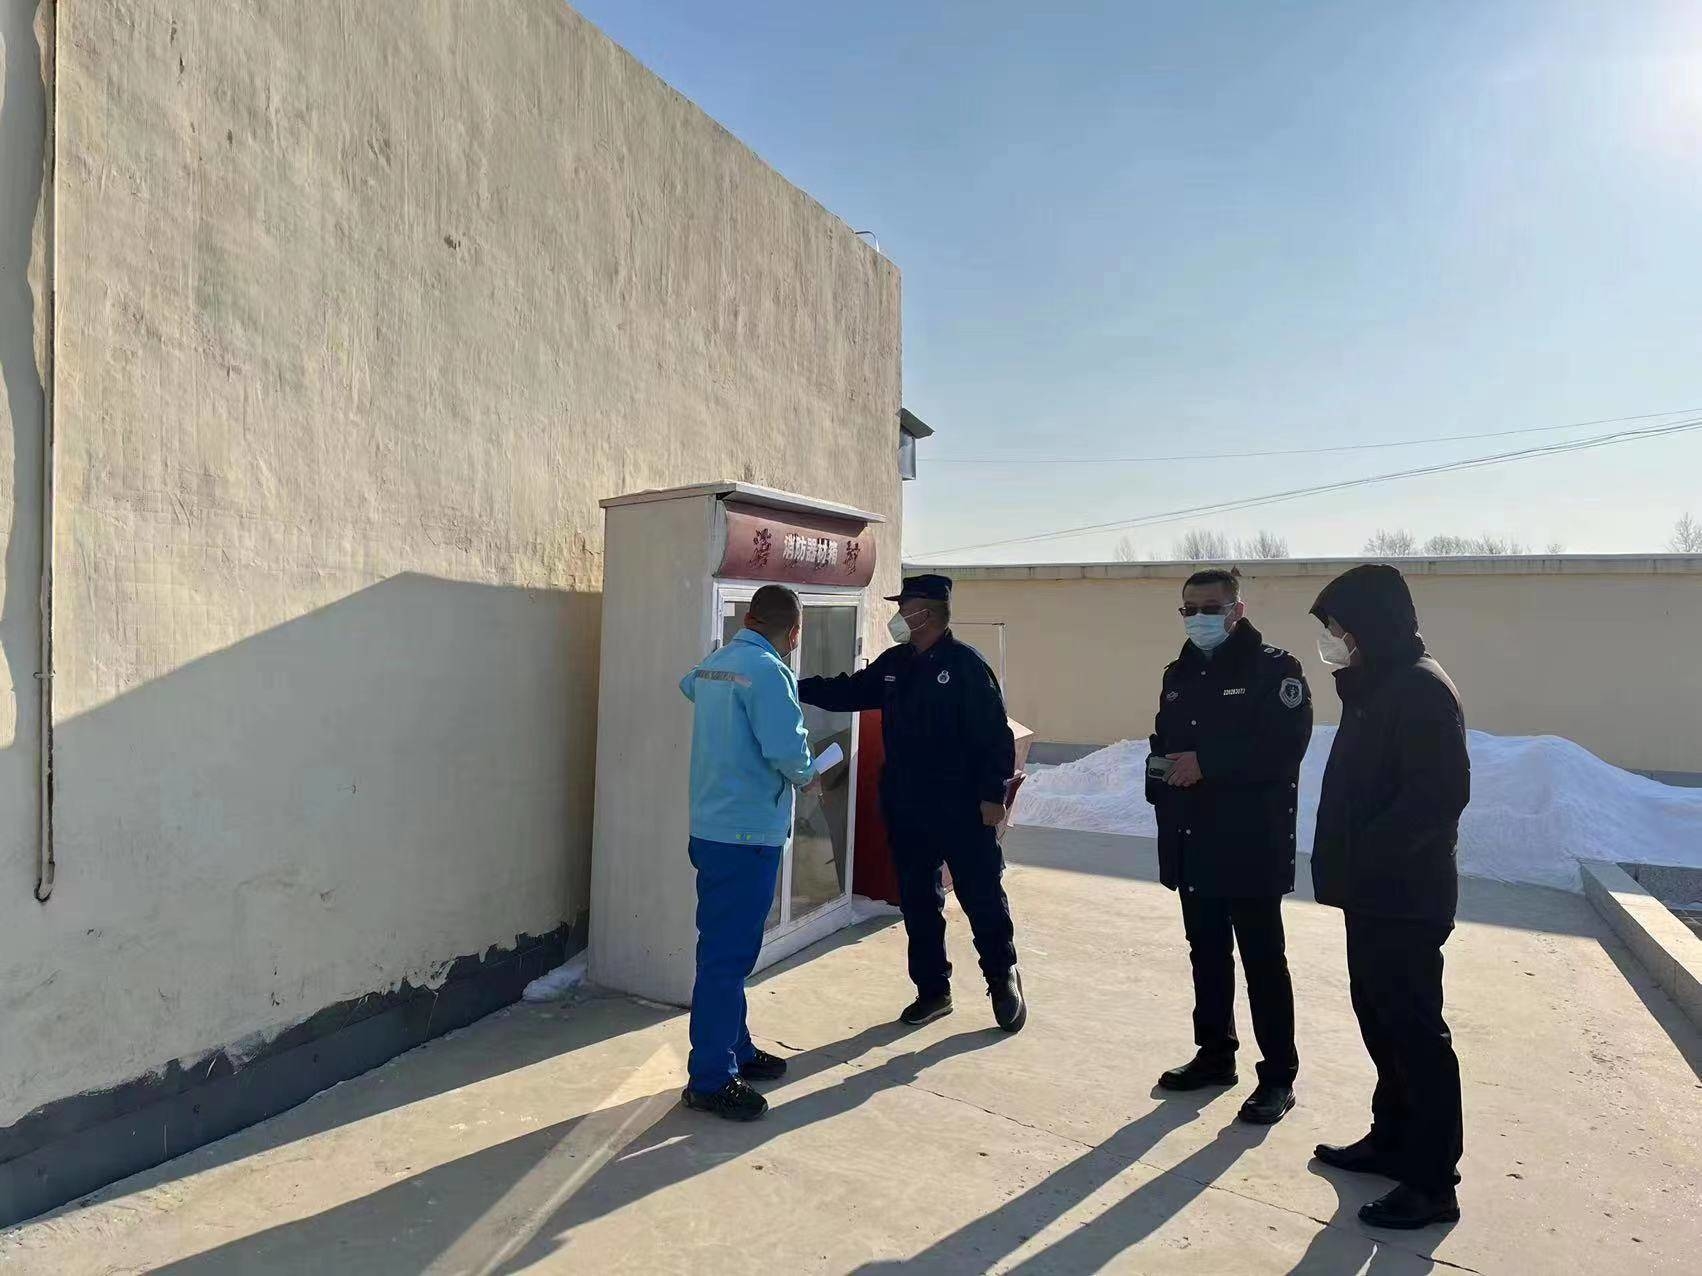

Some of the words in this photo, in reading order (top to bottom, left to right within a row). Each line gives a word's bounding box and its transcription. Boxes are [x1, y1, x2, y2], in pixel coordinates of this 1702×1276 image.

[783, 533, 839, 565] 消防器材箱
